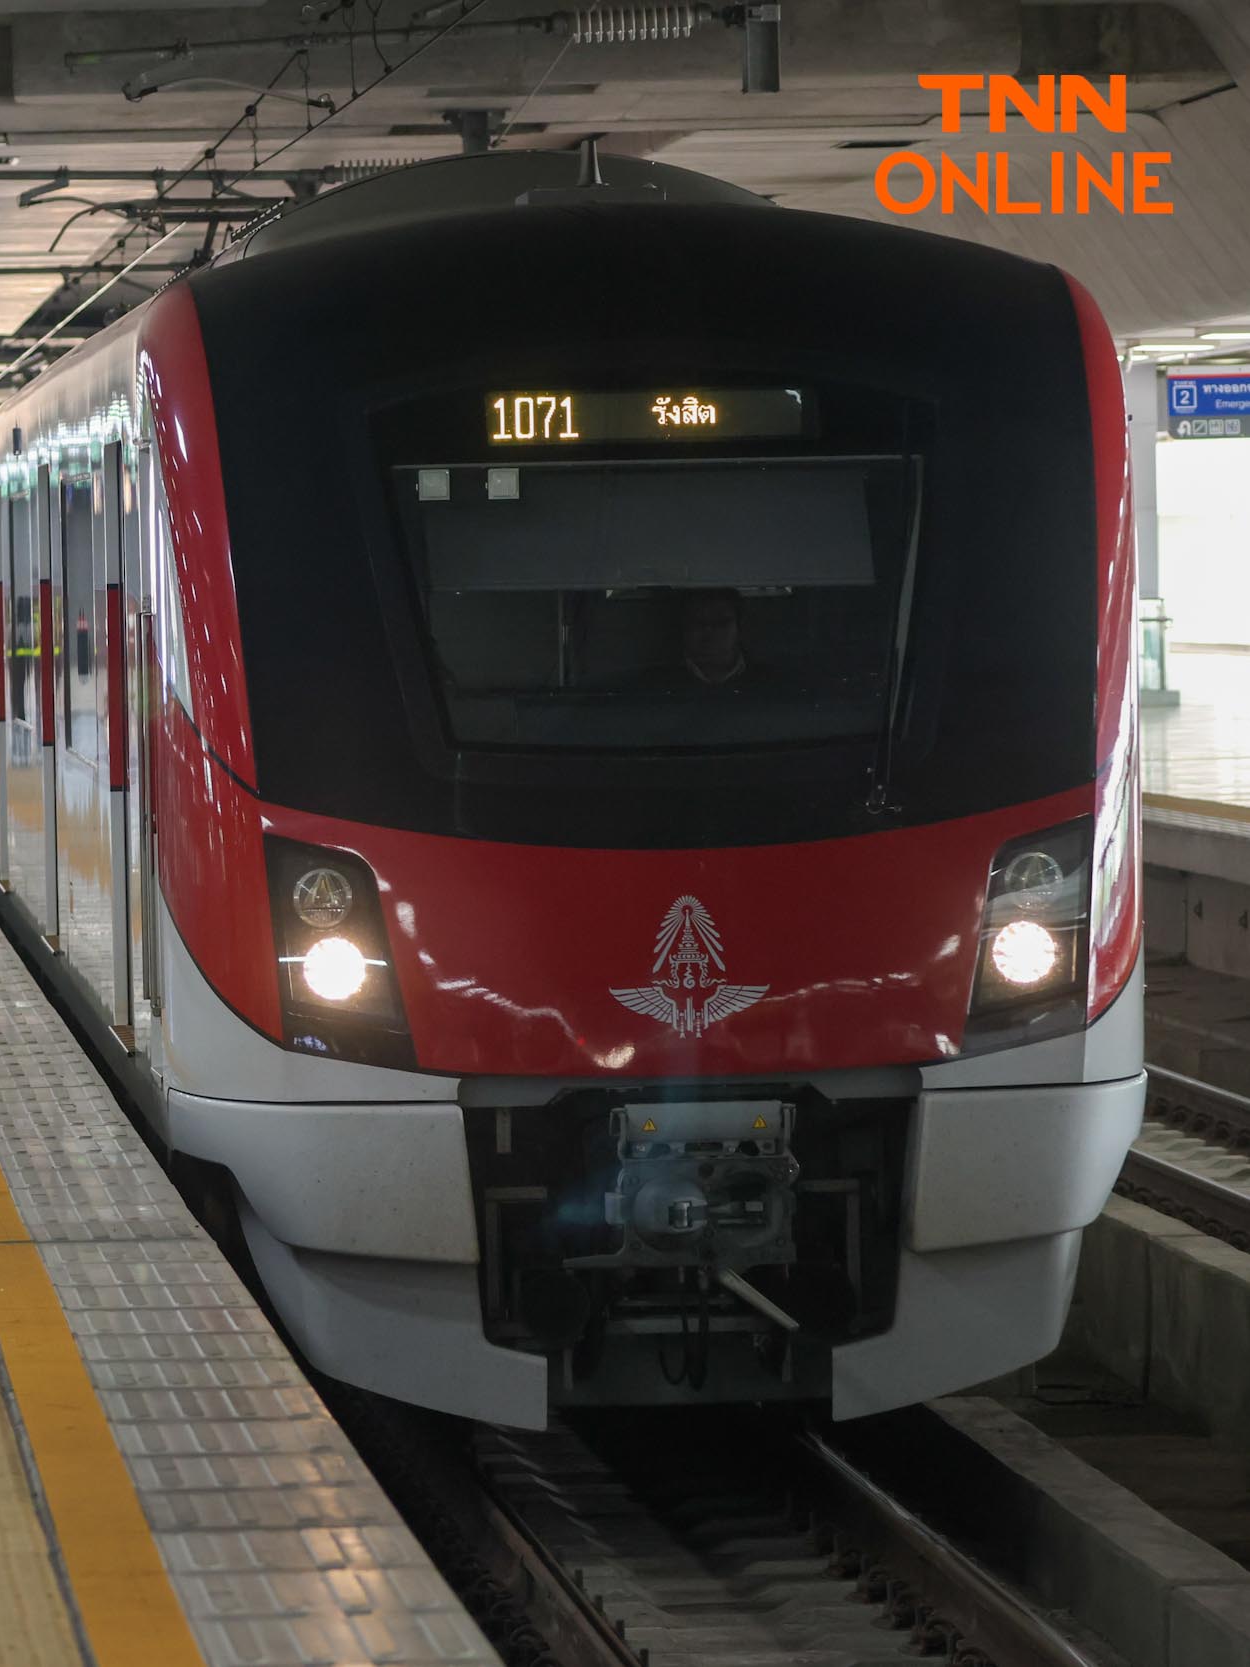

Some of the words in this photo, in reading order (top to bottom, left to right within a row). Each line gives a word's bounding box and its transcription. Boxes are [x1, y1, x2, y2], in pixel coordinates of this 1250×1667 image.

[652, 396, 716, 424] รังสิต
[1179, 390, 1190, 405] 2
[493, 396, 579, 439] 1071
